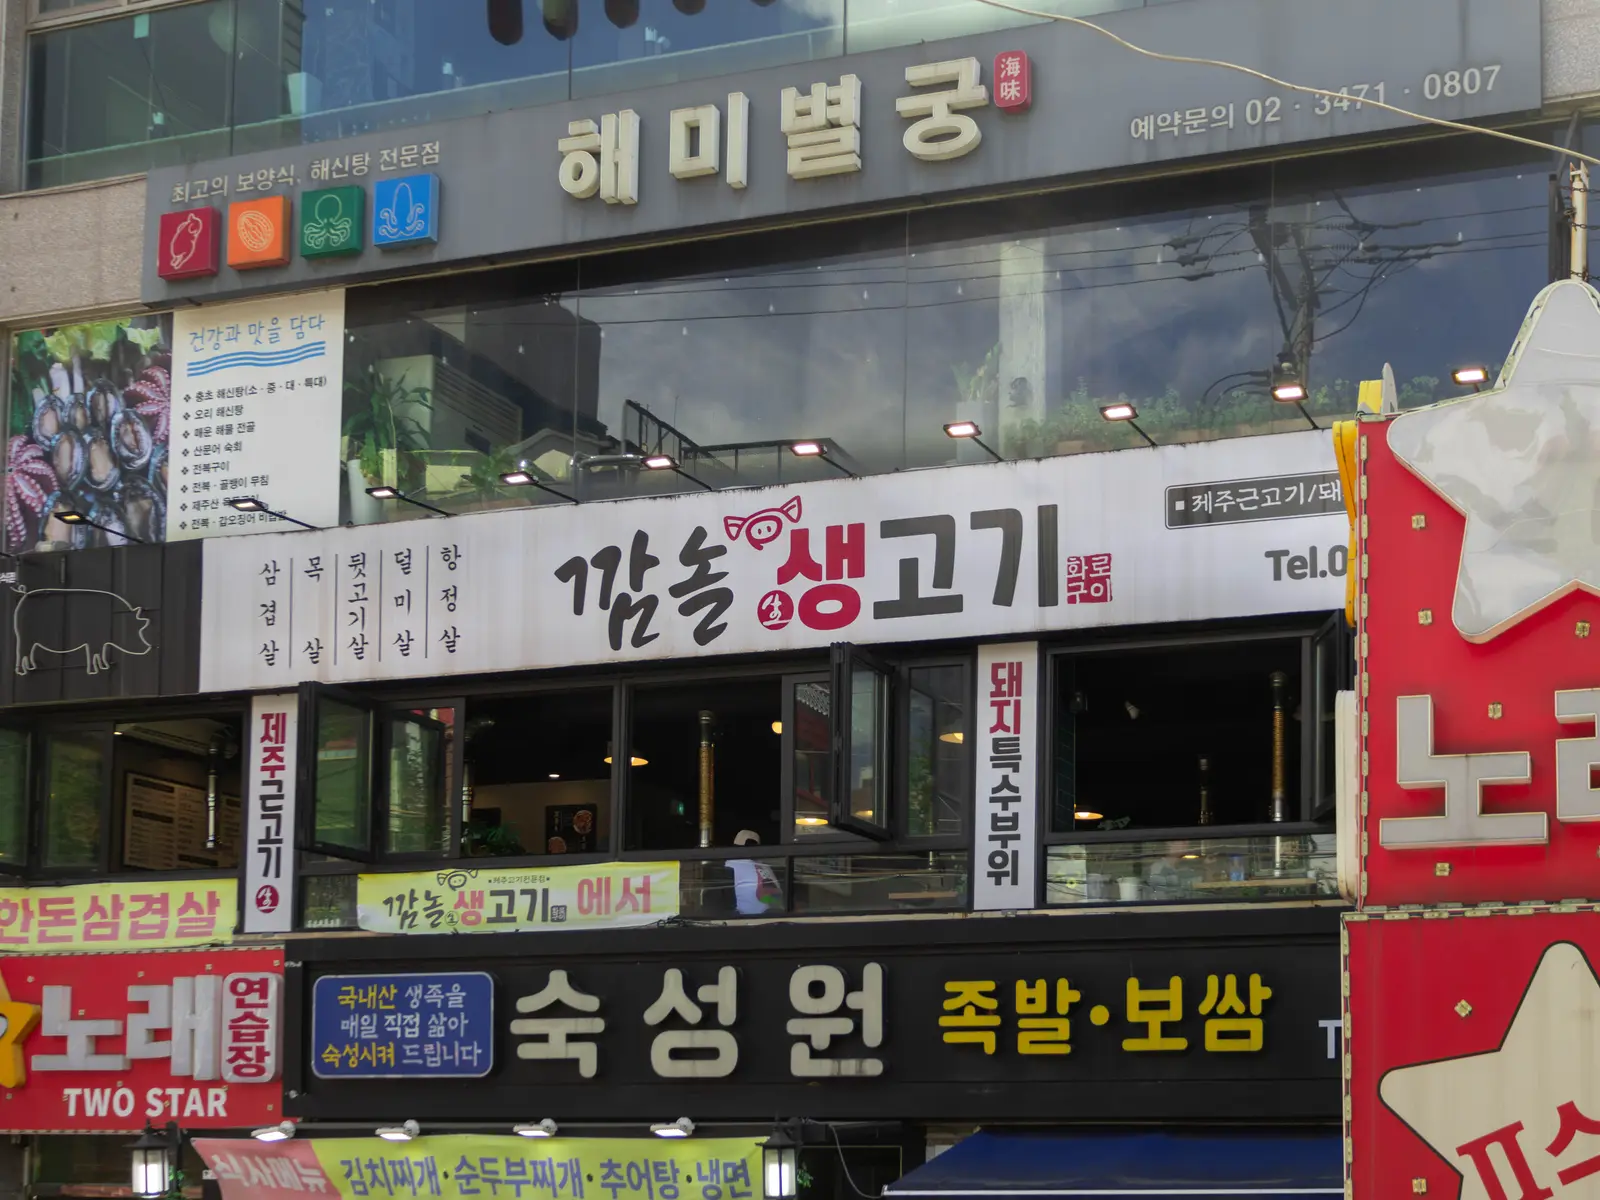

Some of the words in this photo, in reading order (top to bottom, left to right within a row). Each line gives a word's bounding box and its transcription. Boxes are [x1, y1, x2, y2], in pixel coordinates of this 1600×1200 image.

[999, 57, 1021, 101] 海味
[1130, 102, 1235, 141] 예약문의
[1245, 96, 1281, 125] 02
[1314, 81, 1386, 116] 3471
[1423, 65, 1502, 100] 0807
[558, 57, 990, 205] 해미별궁
[171, 175, 229, 203] 최고의
[310, 152, 371, 182] 해신탕
[379, 140, 441, 172] 전문점
[189, 323, 241, 353] 건강과
[248, 316, 282, 345] 맛을
[290, 313, 326, 340] 담다
[194, 408, 213, 420] 오리
[216, 404, 244, 418] 해신탕
[194, 426, 213, 439] 매운
[216, 424, 234, 436] 해물
[237, 421, 256, 434] 전골
[192, 481, 211, 494] 전복
[220, 476, 247, 490] 골뱅이
[250, 474, 270, 487] 무침
[193, 460, 230, 475] 전복구이
[191, 517, 210, 530] 전복
[219, 513, 256, 527] 갑오징어
[192, 498, 220, 512] 제주산
[259, 560, 281, 667] 삼겹살
[347, 552, 369, 661] 뒷고기살
[393, 548, 415, 657] 덜미살
[439, 544, 461, 654] 항정살
[257, 712, 287, 879] 제주근고기
[986, 661, 1023, 886] 돼지특수부위
[0, 890, 221, 945] 한돈삼겹살
[577, 875, 652, 916] 에서
[337, 984, 398, 1010] 국내산
[405, 983, 467, 1009] 생족을
[31, 975, 223, 1081] 노래
[227, 977, 271, 1078] 연습장
[341, 1013, 379, 1039] 매일
[384, 1013, 420, 1039] 직접
[427, 1012, 469, 1038] 삶아
[510, 961, 884, 1078] 숙성원
[321, 1041, 396, 1069] 숙성시켜
[402, 1041, 482, 1068] 드립니다
[63, 1088, 136, 1117] TWO
[146, 1087, 228, 1117] STAR
[211, 1153, 327, 1194] 식사메뉴
